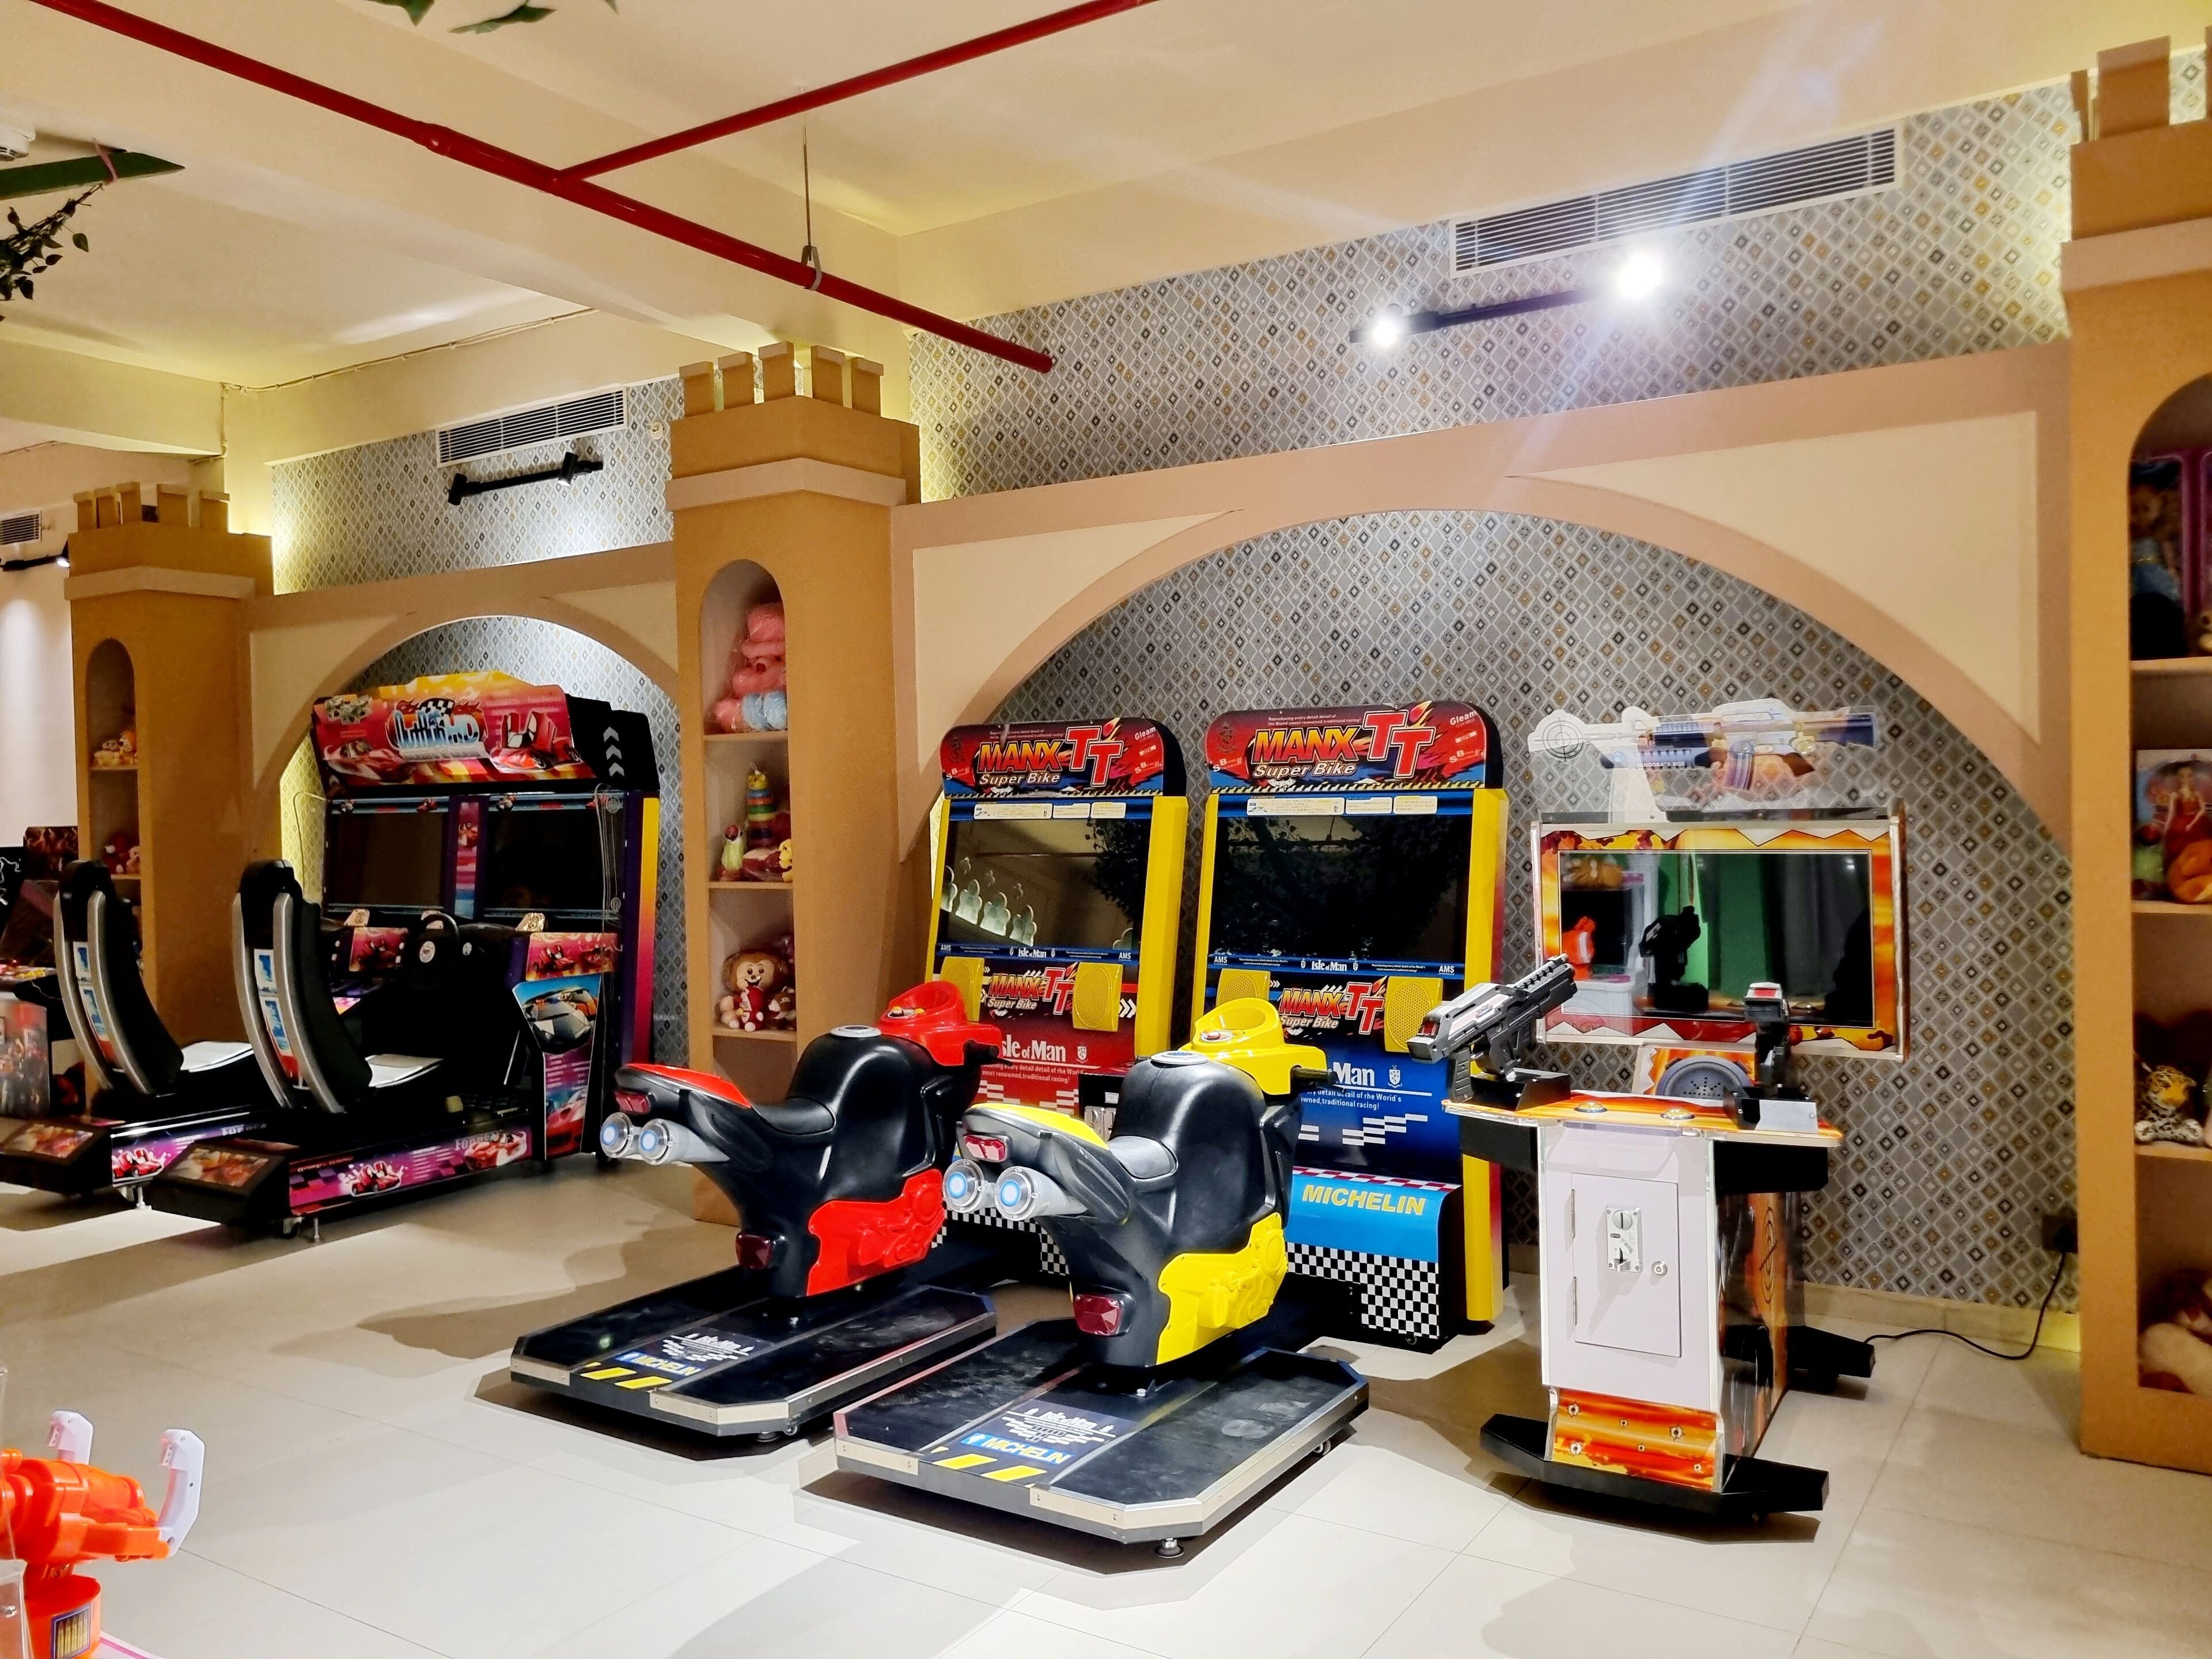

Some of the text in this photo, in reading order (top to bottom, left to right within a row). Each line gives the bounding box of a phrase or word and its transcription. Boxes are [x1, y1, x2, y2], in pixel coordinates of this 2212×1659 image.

[1450, 710, 1477, 725] Gleam
[1135, 726, 1156, 740] Gleam
[1251, 726, 1361, 764] MANX
[978, 740, 1063, 773] MANX
[979, 772, 1060, 786] Super Bike
[1253, 763, 1309, 778] Super
[1312, 762, 1356, 776] Bike
[1018, 947, 1029, 957] Isle
[1033, 949, 1047, 958] Man
[1312, 959, 1325, 971] Isle
[1330, 961, 1347, 972] Man
[988, 974, 1042, 1000] MANX
[987, 998, 1037, 1010] Super Bike
[1279, 988, 1344, 1018] MANX
[1281, 1016, 1339, 1029] Super Bike
[1002, 1035, 1066, 1062] sle of Man
[1333, 1062, 1375, 1087] Man
[1357, 1101, 1380, 1111] racing!
[1302, 1184, 1426, 1216] MICHELIN
[634, 1355, 703, 1376] MICHELIN
[981, 1437, 1071, 1465] MICHELIN
